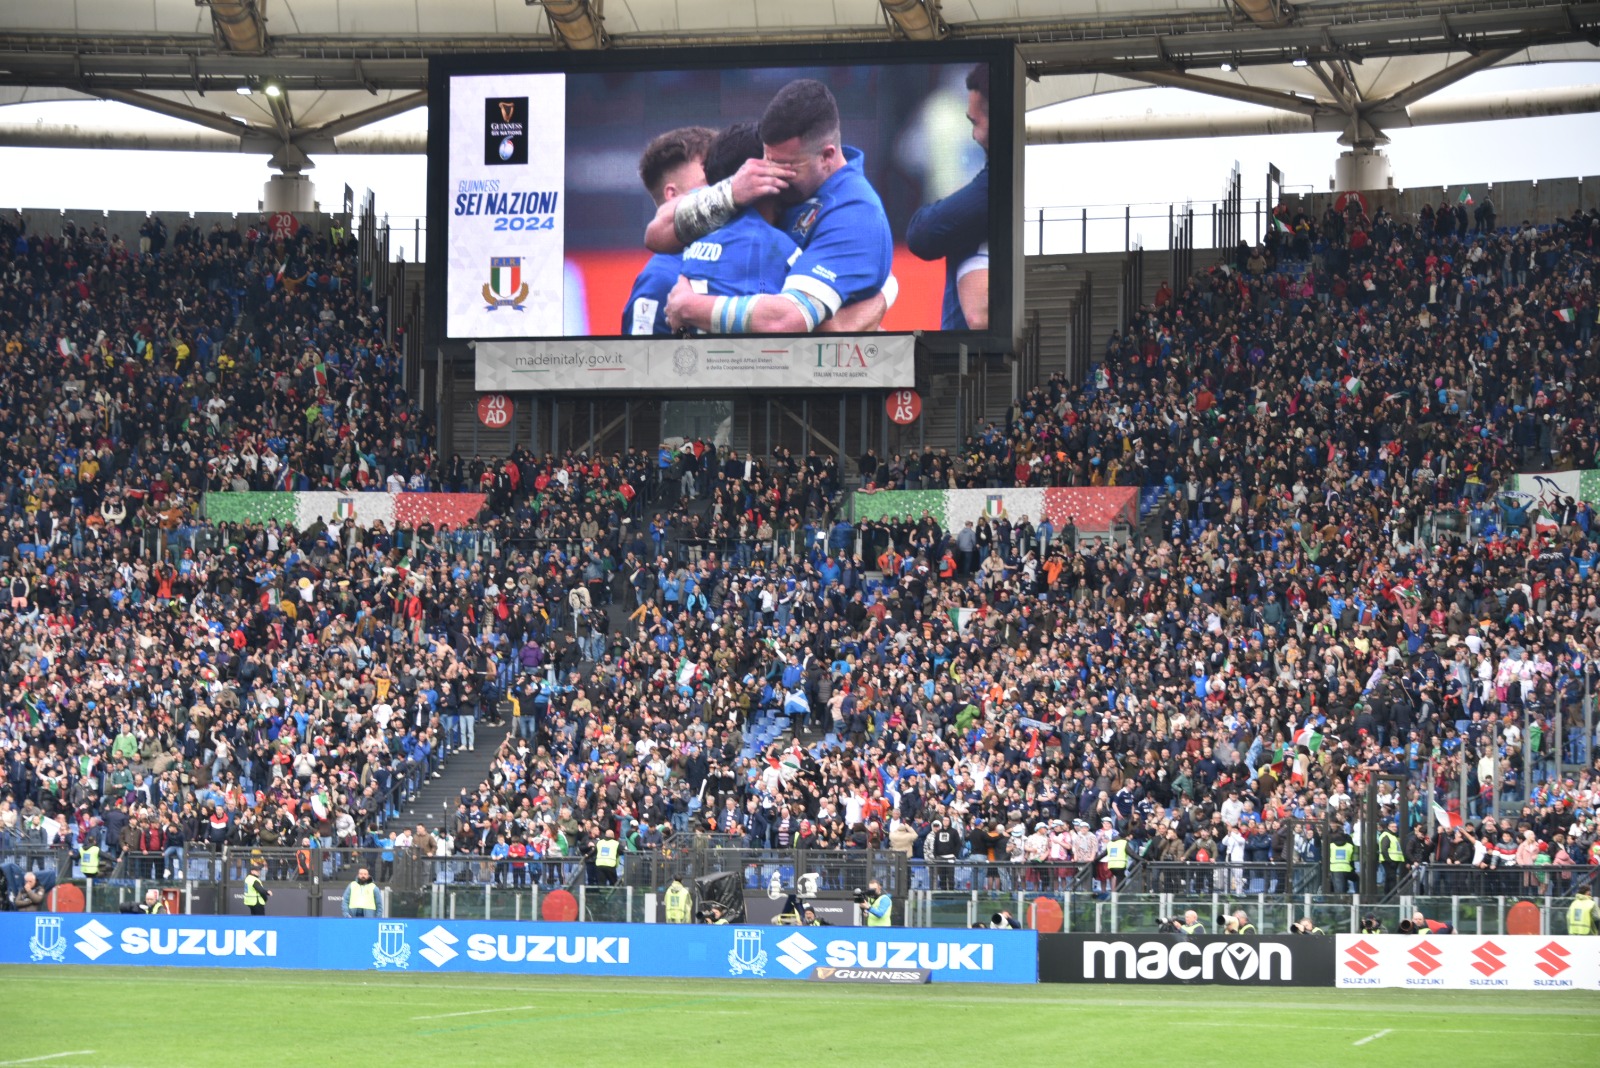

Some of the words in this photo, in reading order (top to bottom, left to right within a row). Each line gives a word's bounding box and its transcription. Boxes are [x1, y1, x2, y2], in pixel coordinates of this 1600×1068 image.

[458, 180, 501, 193] GUINNESS
[454, 193, 483, 216] SEI
[484, 192, 558, 215] NAZIONI
[275, 214, 291, 228] 20
[493, 216, 554, 231] 2024
[515, 352, 623, 367] madeinitaly.gov.it
[815, 343, 868, 368] ITA
[488, 394, 505, 409] 20
[895, 391, 912, 405] 19
[485, 409, 507, 424] AD
[894, 405, 913, 420] AS
[120, 927, 277, 957] SUZUKI
[466, 933, 630, 964] SUZUKI
[825, 940, 994, 971] SUZUKI
[1083, 940, 1292, 981] macron
[834, 969, 921, 981] GUINNESS
[1342, 977, 1381, 985] SUZUKI
[1533, 979, 1573, 987] SUZUKI
